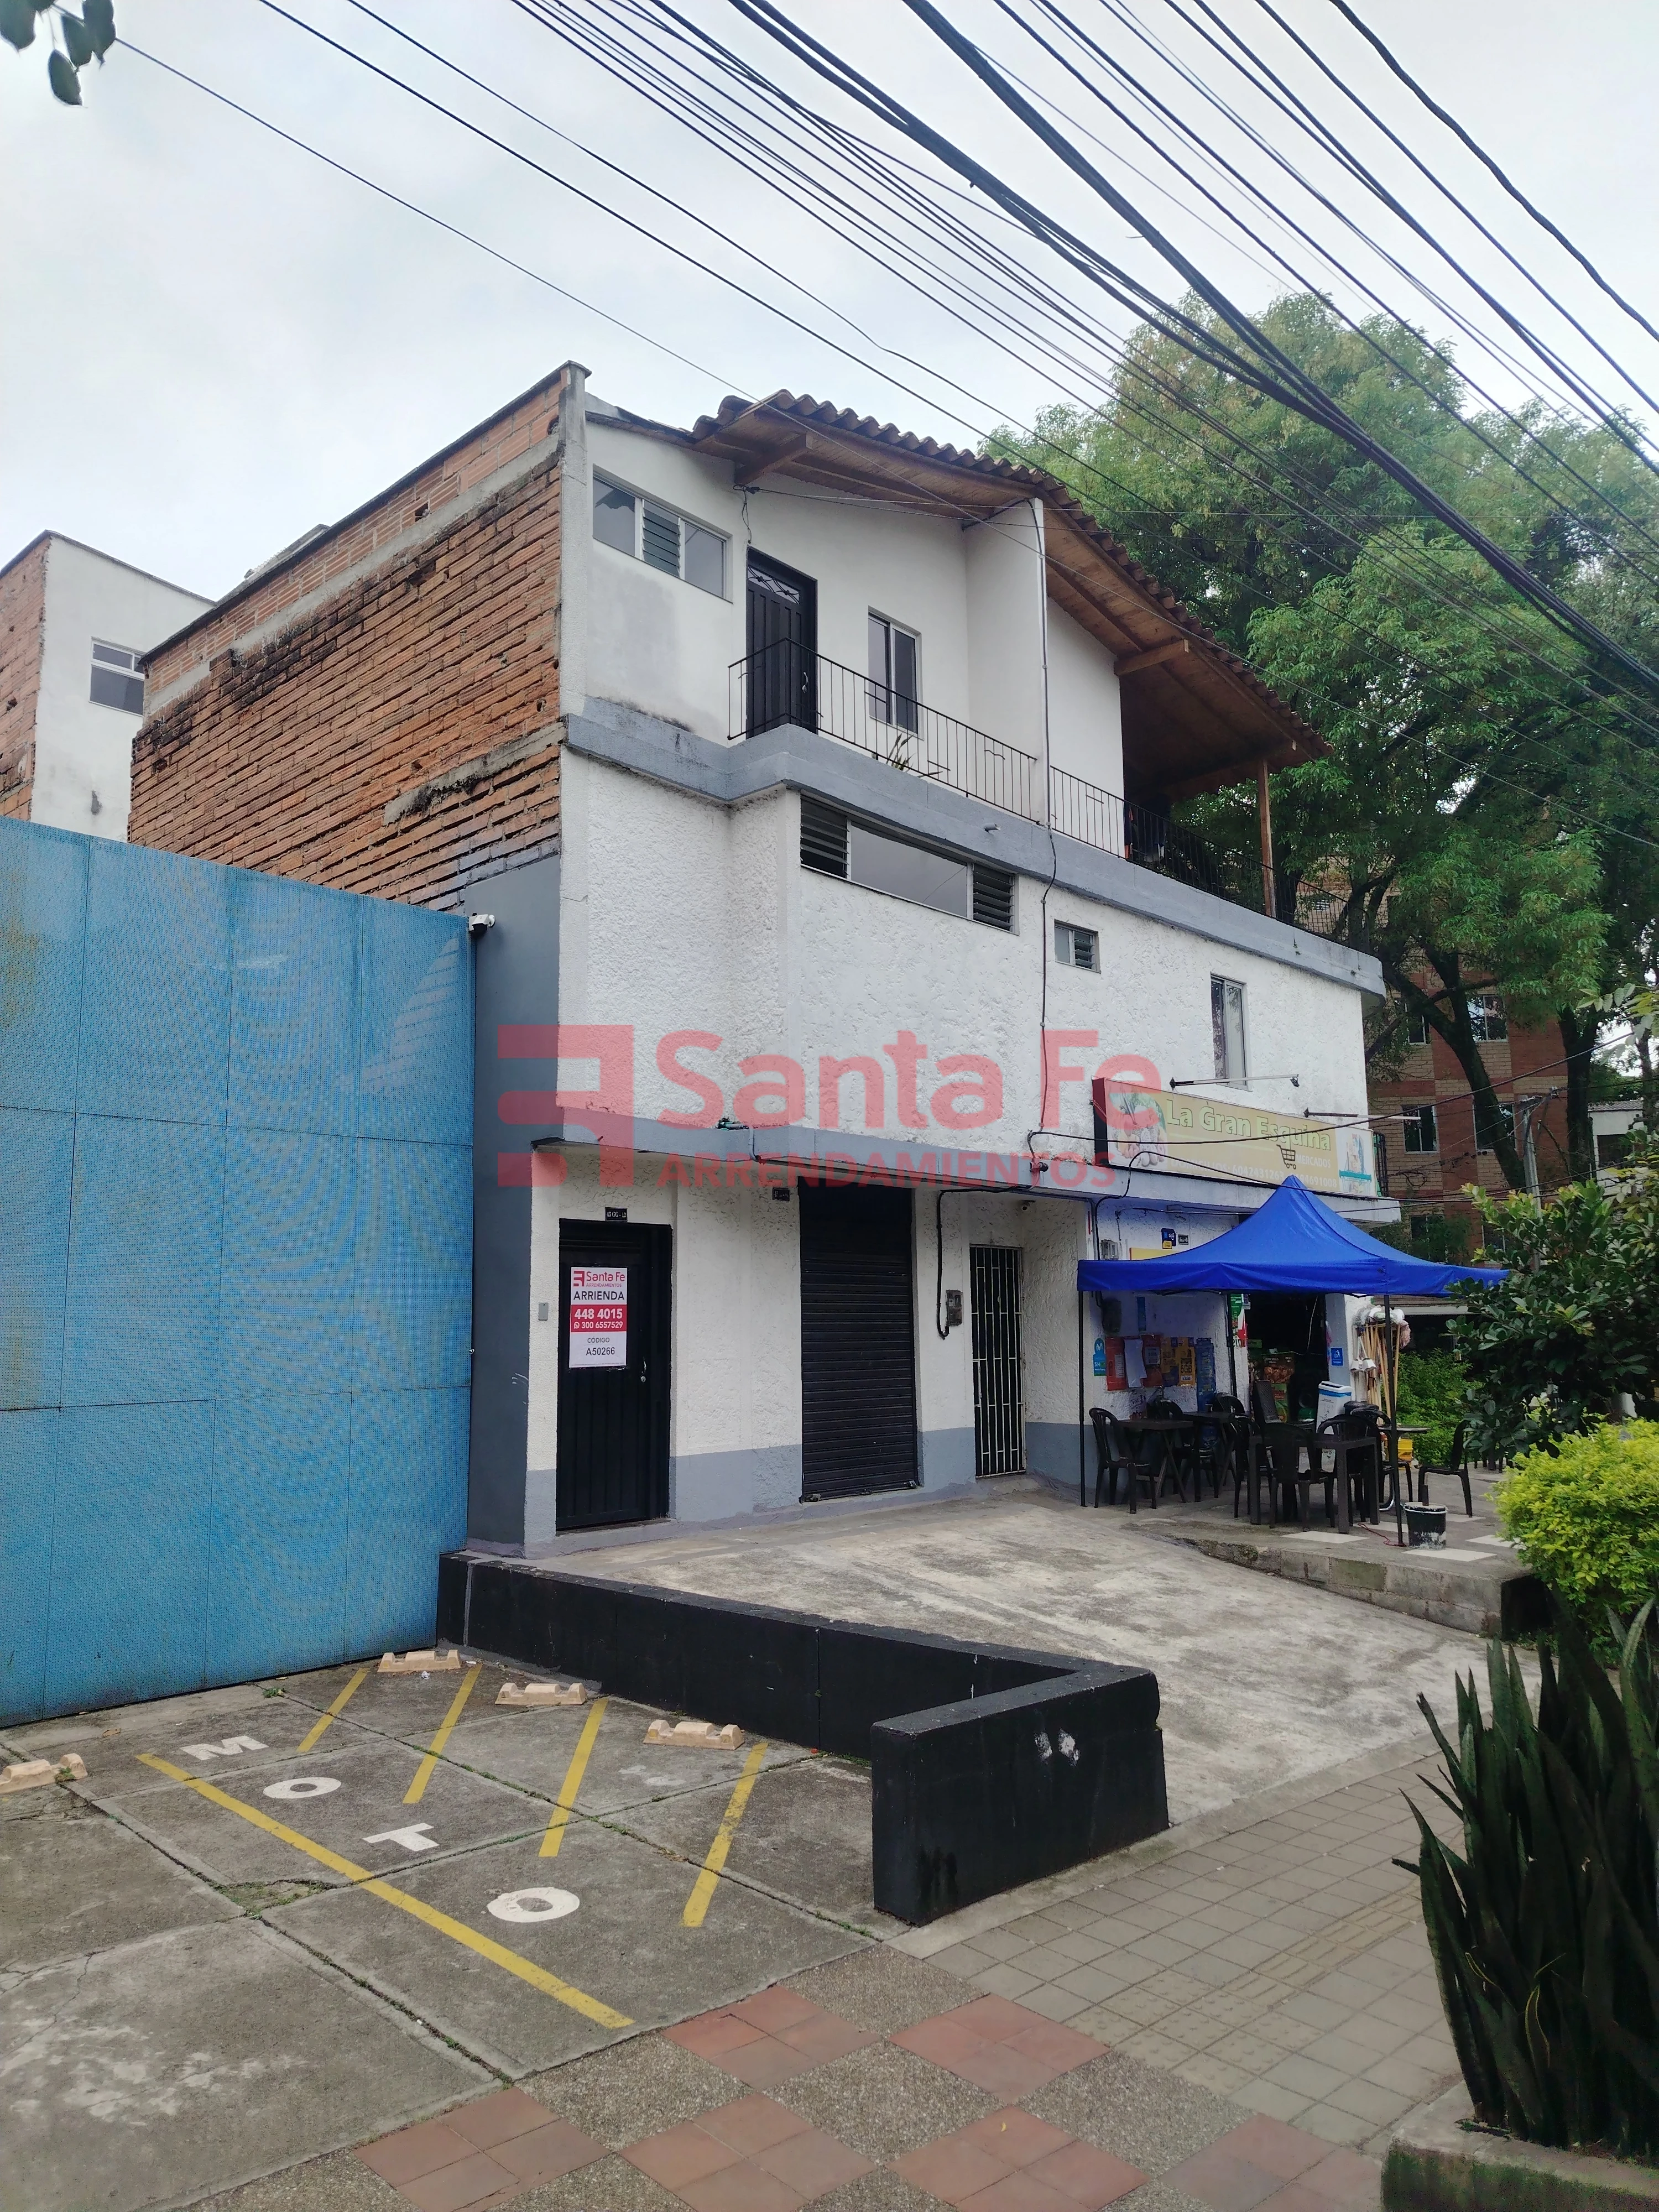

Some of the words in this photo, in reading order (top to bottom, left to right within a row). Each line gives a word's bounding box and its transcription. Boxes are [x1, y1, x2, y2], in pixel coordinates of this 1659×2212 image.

[1166, 1098, 1193, 1128] La
[1198, 1106, 1252, 1138] Gran
[1256, 1115, 1332, 1151] Esquina
[1295, 1154, 1331, 1168] MERCADOS
[586, 1271, 613, 1282] Santa
[615, 1271, 625, 1282] Fe
[573, 1291, 625, 1300] ARRIENDA
[574, 1308, 594, 1319] 448
[597, 1308, 623, 1319] 4015
[595, 1321, 623, 1329] 6557529
[586, 1347, 615, 1356] A50266
